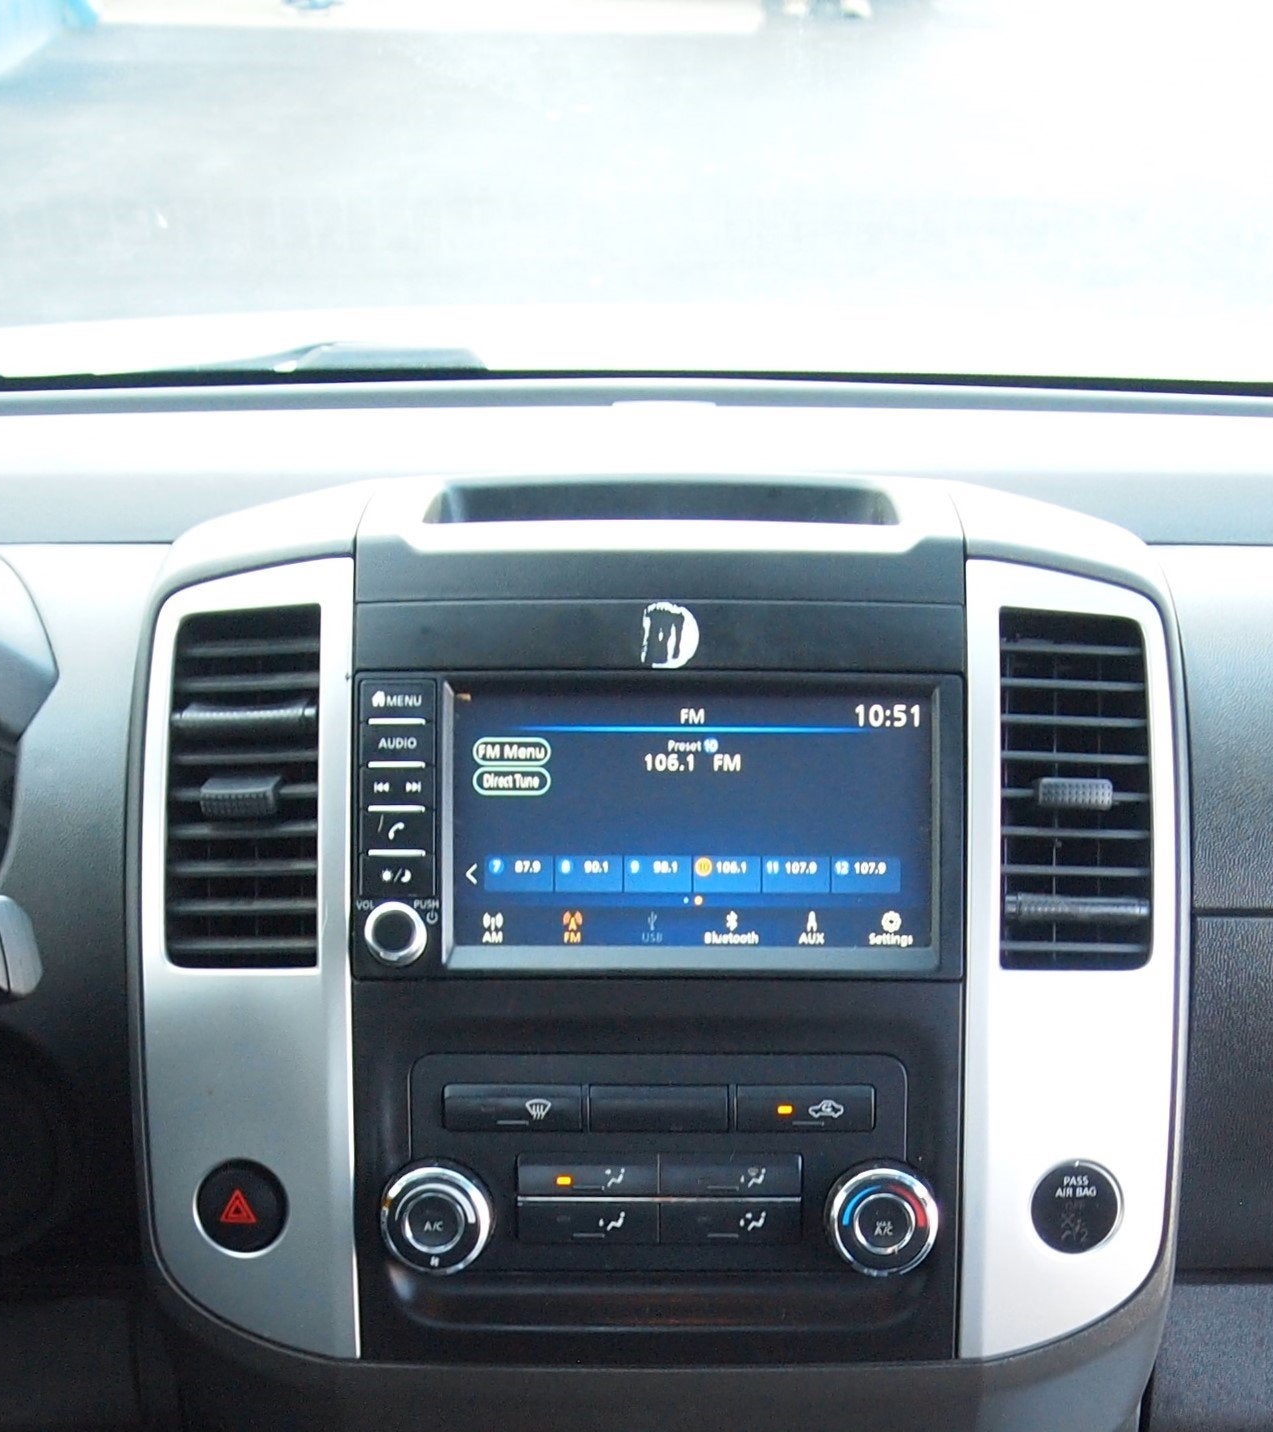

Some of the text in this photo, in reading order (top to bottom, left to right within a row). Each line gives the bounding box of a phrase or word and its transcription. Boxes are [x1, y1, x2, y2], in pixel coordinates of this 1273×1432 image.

[386, 694, 422, 707] MENU
[679, 708, 705, 725] FM
[854, 704, 921, 728] 10:51
[378, 737, 418, 750] AUDIO
[668, 739, 701, 753] Preset
[478, 743, 545, 760] FM Menu
[644, 753, 741, 772] 106.1 FM
[482, 773, 540, 789] Direct Tune
[514, 860, 542, 874] 87.9
[583, 860, 609, 874] 90.1
[356, 900, 374, 911] VOL
[413, 899, 439, 910] PUSH
[482, 931, 504, 944] AM
[563, 931, 582, 944] FM
[642, 932, 663, 944] USB
[703, 930, 759, 945] Bluetooth
[798, 931, 825, 945] AUX
[868, 932, 914, 948] Settings
[1063, 1175, 1089, 1187] PASS
[1055, 1186, 1097, 1198] AIR BAG
[423, 1220, 444, 1232] A/C
